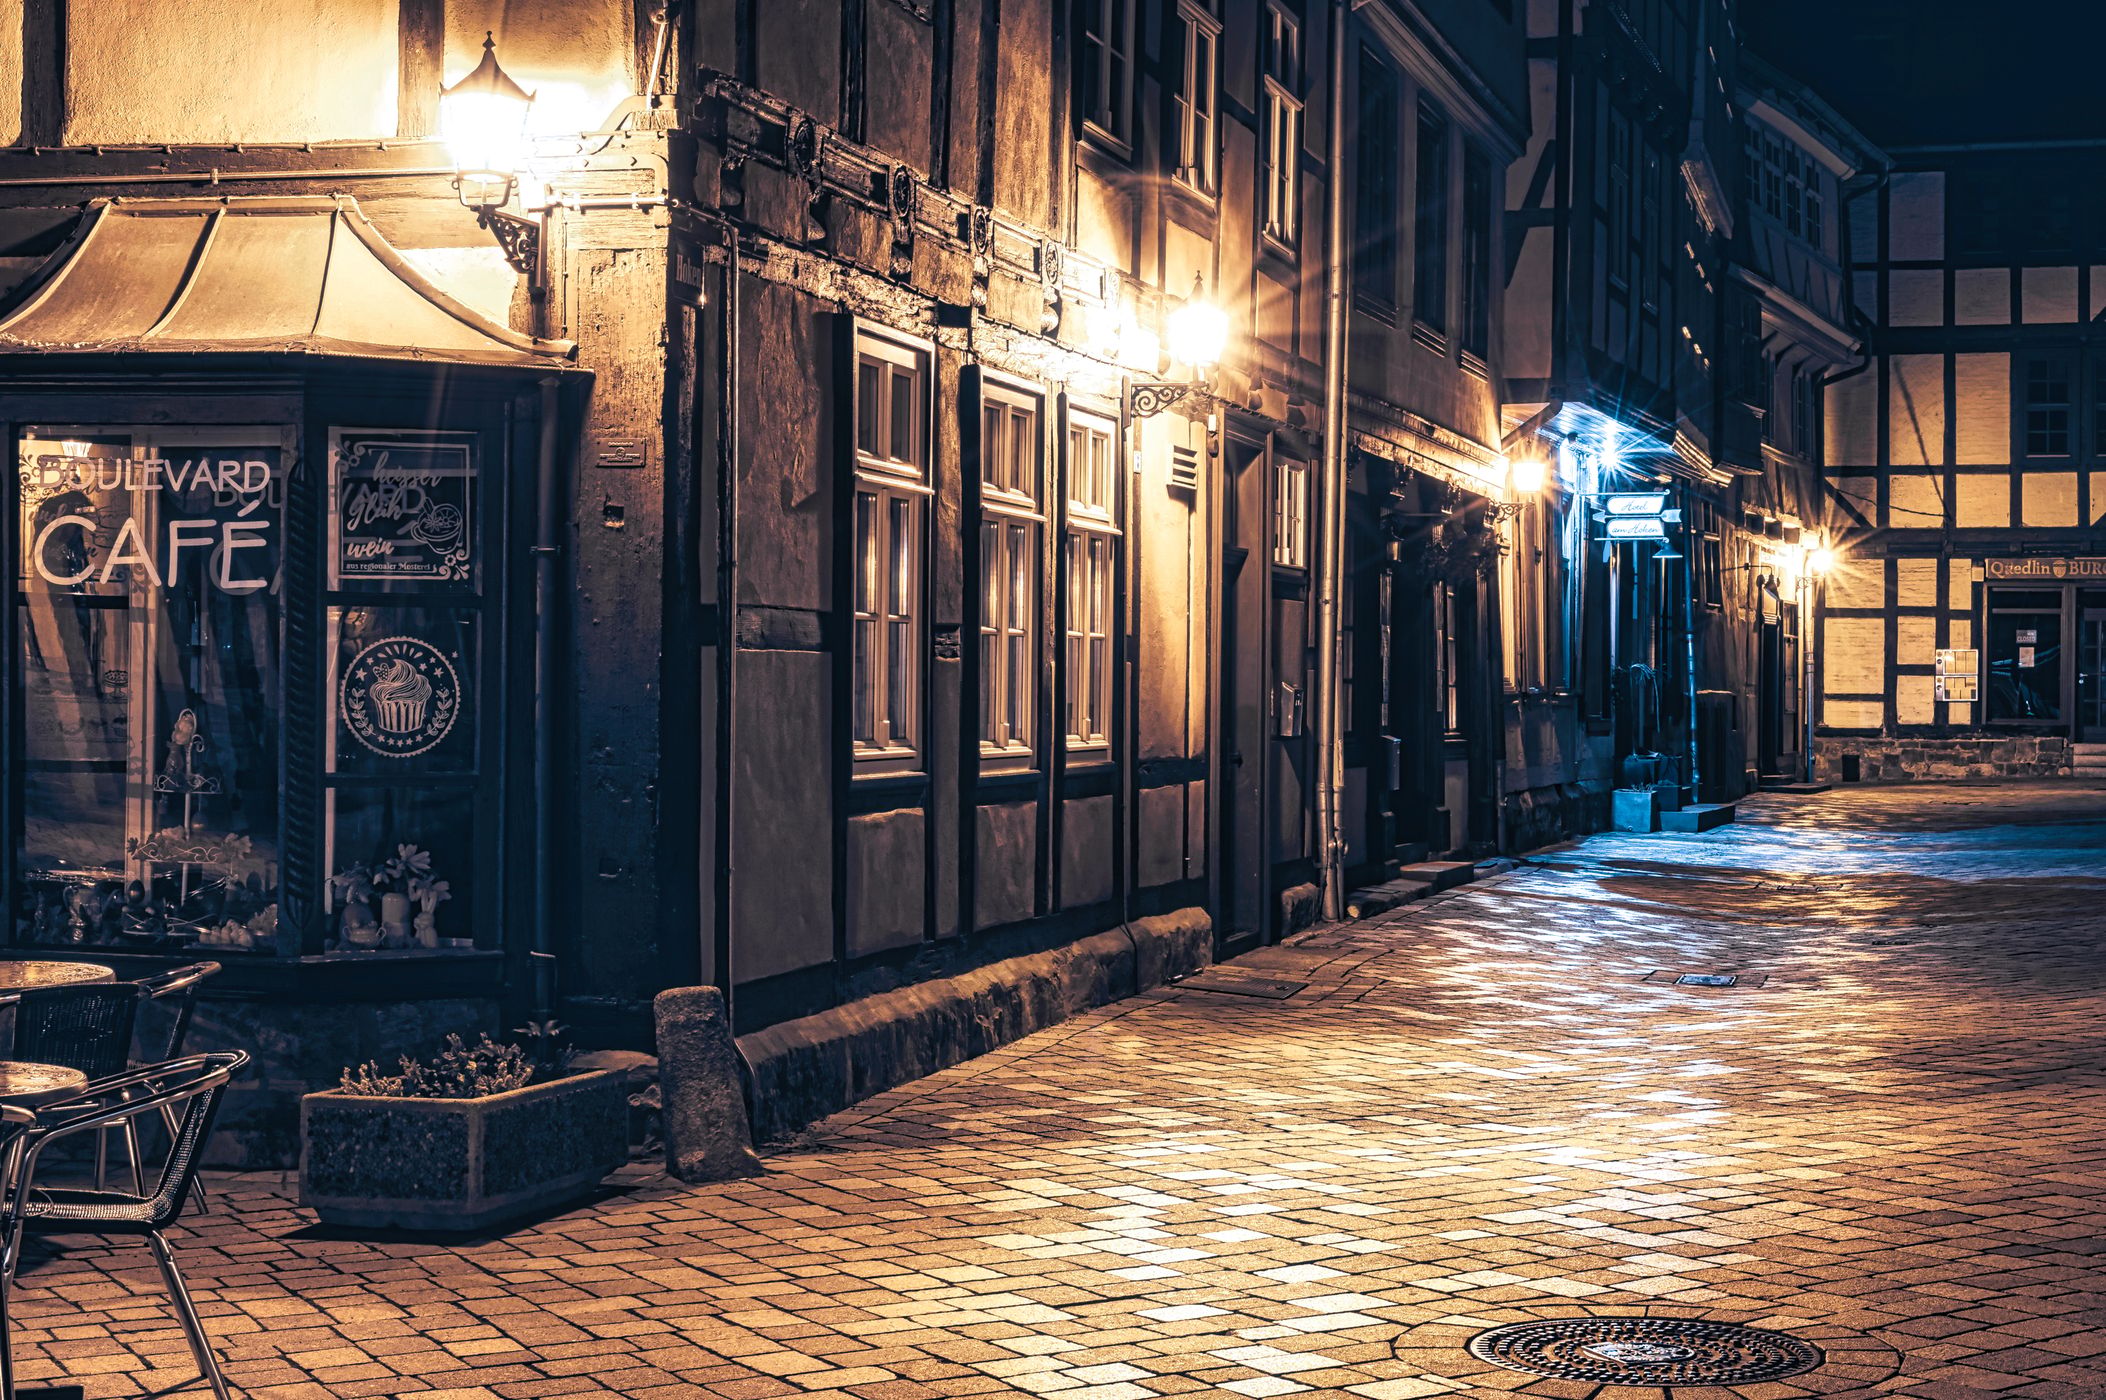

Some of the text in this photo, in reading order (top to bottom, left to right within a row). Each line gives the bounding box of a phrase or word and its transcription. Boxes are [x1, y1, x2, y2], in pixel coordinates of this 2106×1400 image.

[38, 456, 271, 493] BOULEVARD
[1621, 500, 1649, 511] Hotel
[1627, 523, 1659, 534] Hoken
[34, 499, 271, 589] CAFÉ
[347, 537, 395, 558] wein
[360, 562, 397, 572] regionaler
[398, 562, 431, 570] Mosterei
[2068, 561, 2106, 575] BUR
